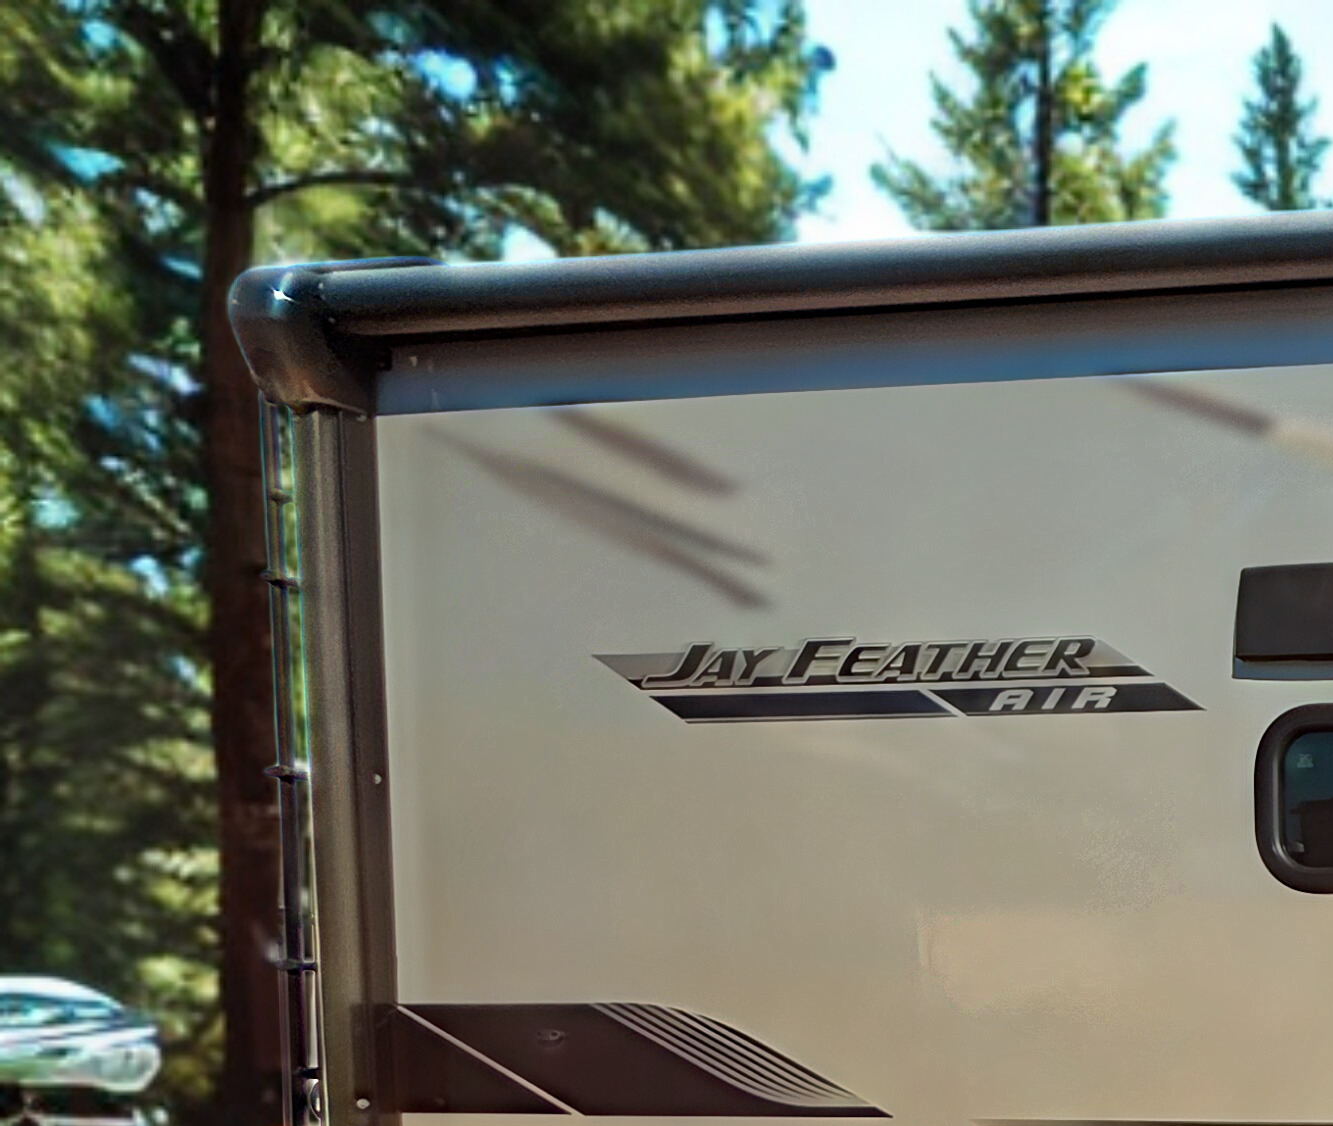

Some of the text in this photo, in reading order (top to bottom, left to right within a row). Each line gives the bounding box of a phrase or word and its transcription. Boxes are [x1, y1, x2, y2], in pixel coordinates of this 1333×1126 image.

[642, 636, 1091, 688] JAY FEATHER
[989, 686, 1117, 711] AIR
